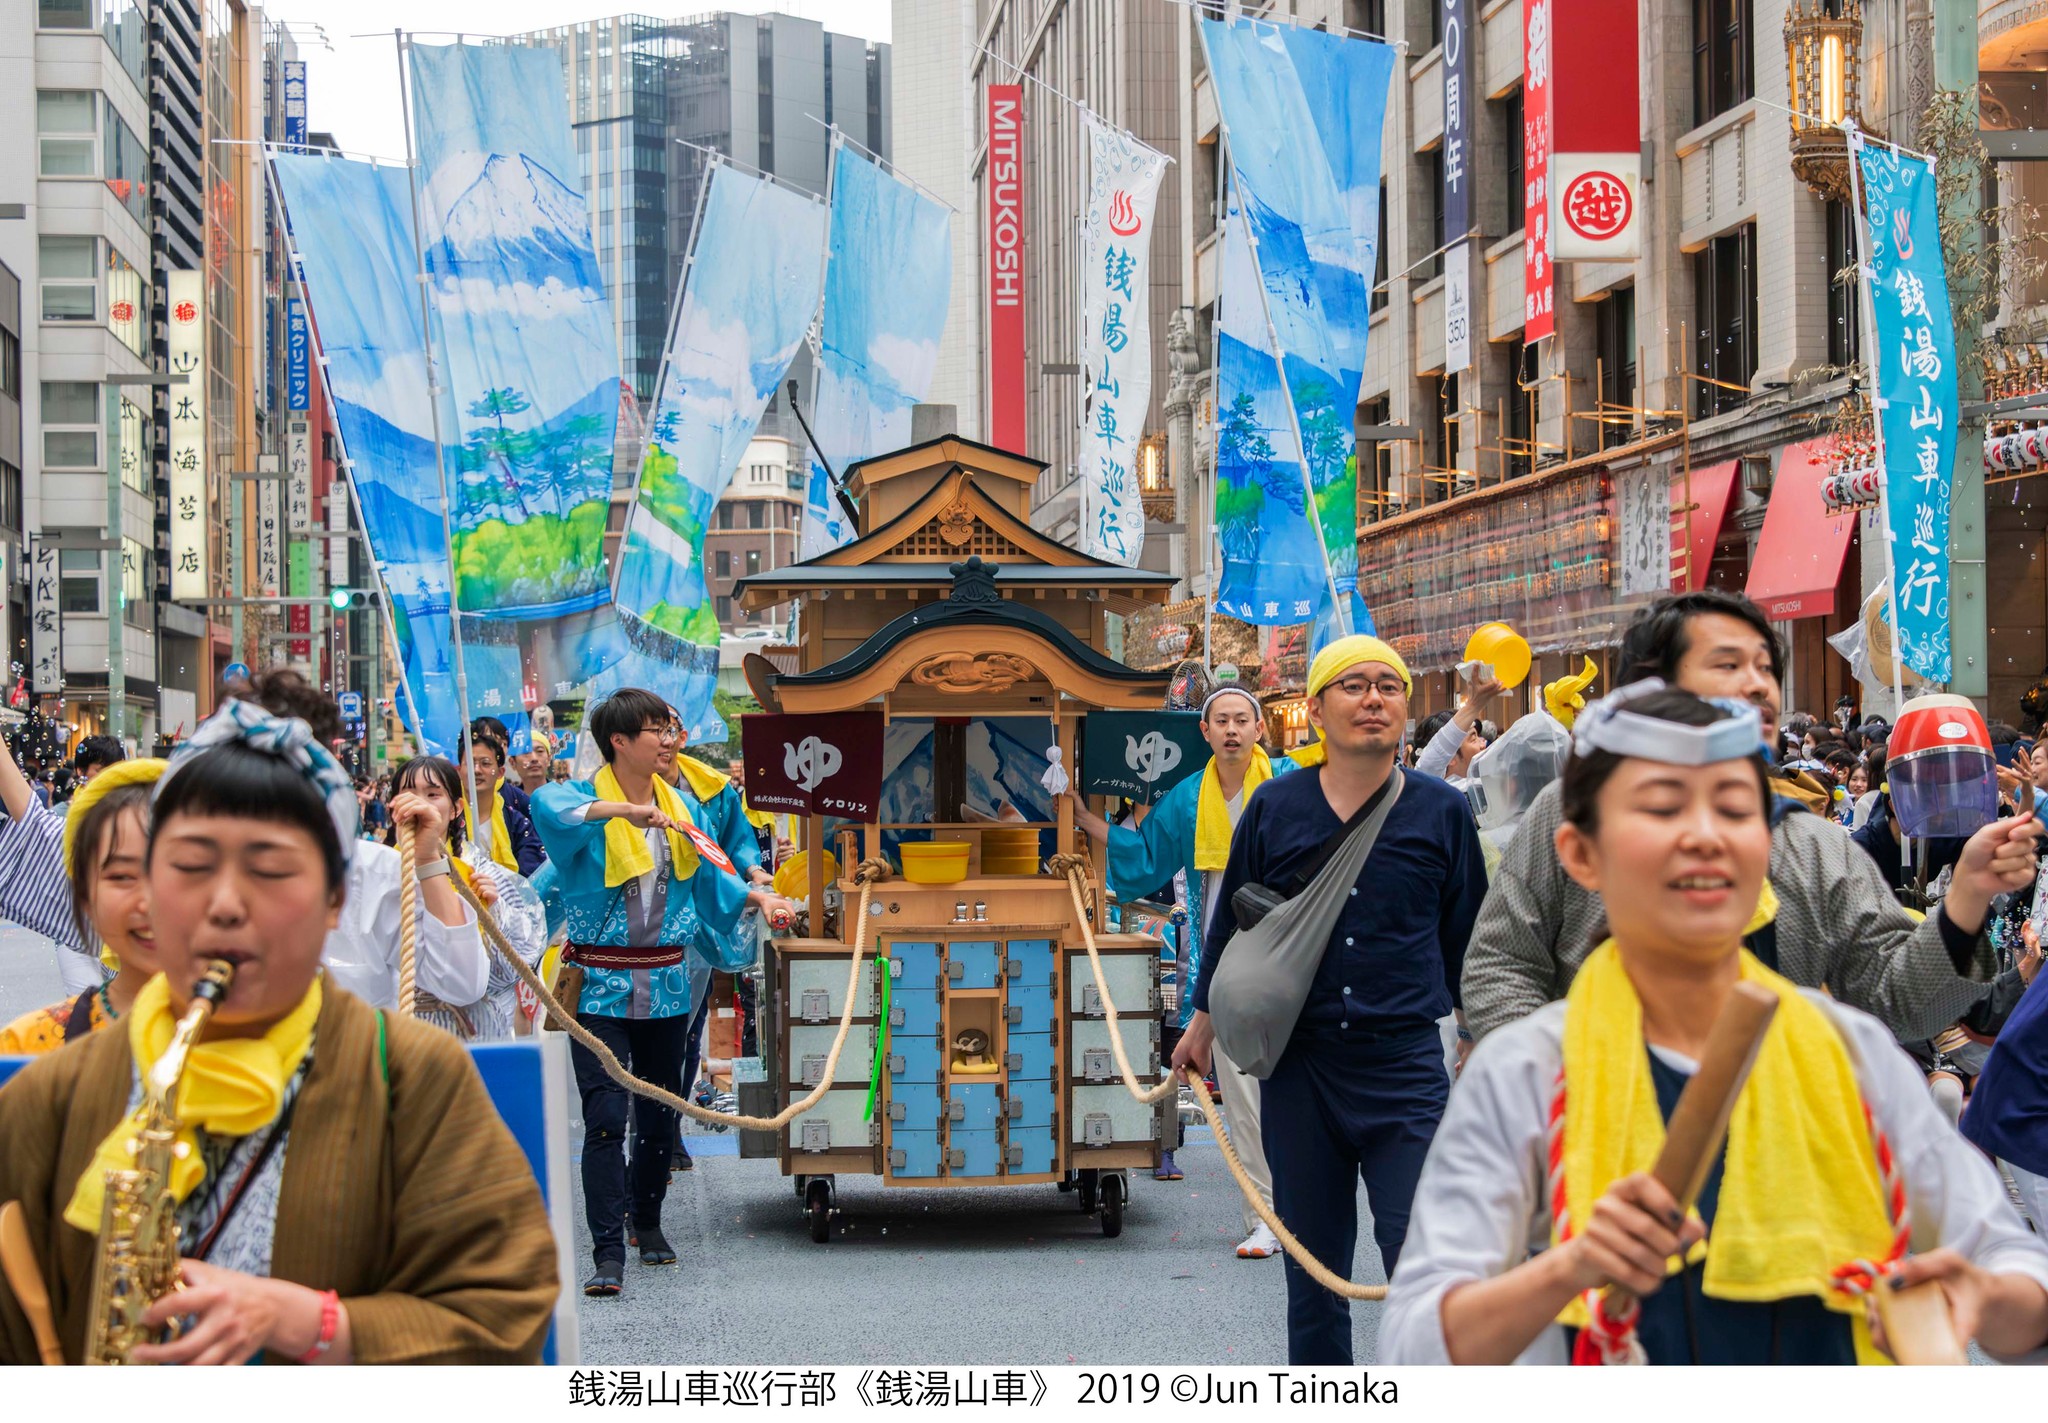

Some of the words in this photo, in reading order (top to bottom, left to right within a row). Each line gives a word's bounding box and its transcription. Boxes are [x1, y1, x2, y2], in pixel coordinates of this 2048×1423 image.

[994, 100, 1018, 307] MITSUKOSHI
[1448, 317, 1466, 344] 350
[1097, 243, 1137, 559] 銭湯山車巡行
[174, 352, 200, 573] 山本海苔店
[1894, 269, 1943, 617] 銭湯山車巡行
[1771, 601, 1802, 615] MITSUKOSHI
[783, 736, 843, 793] ゆ
[1125, 731, 1182, 783] ゆ
[822, 797, 868, 813] ケロリン
[1093, 778, 1143, 794] ノーガホテル
